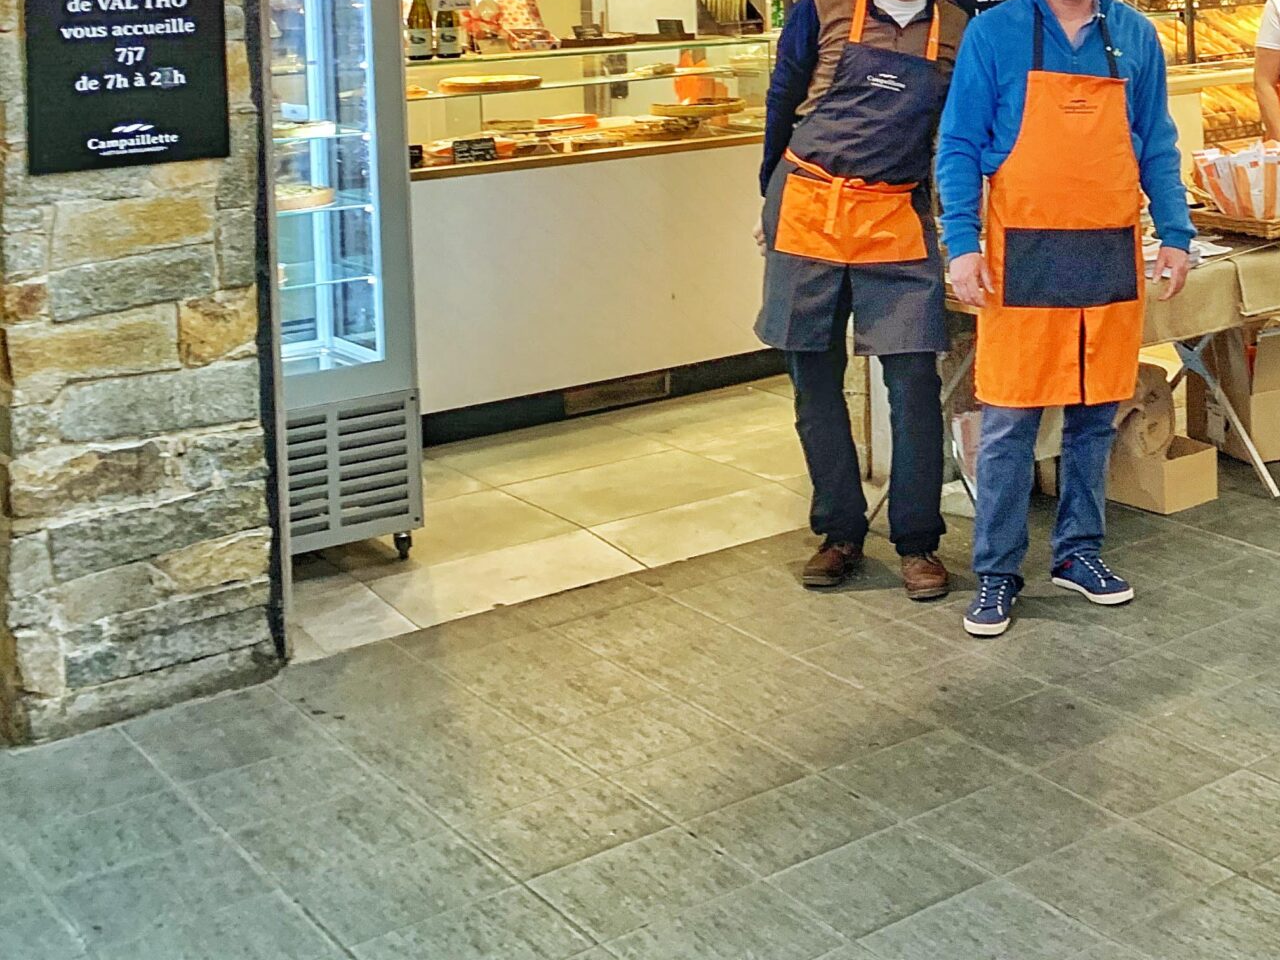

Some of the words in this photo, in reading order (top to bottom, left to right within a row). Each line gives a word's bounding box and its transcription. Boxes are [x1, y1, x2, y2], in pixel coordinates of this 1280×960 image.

[60, 24, 107, 39] vous
[111, 18, 196, 38] accueille
[115, 46, 146, 65] 7j7
[75, 75, 99, 91] de
[103, 73, 130, 90] 7h
[133, 72, 146, 87] à
[87, 133, 179, 150] Campaillette
